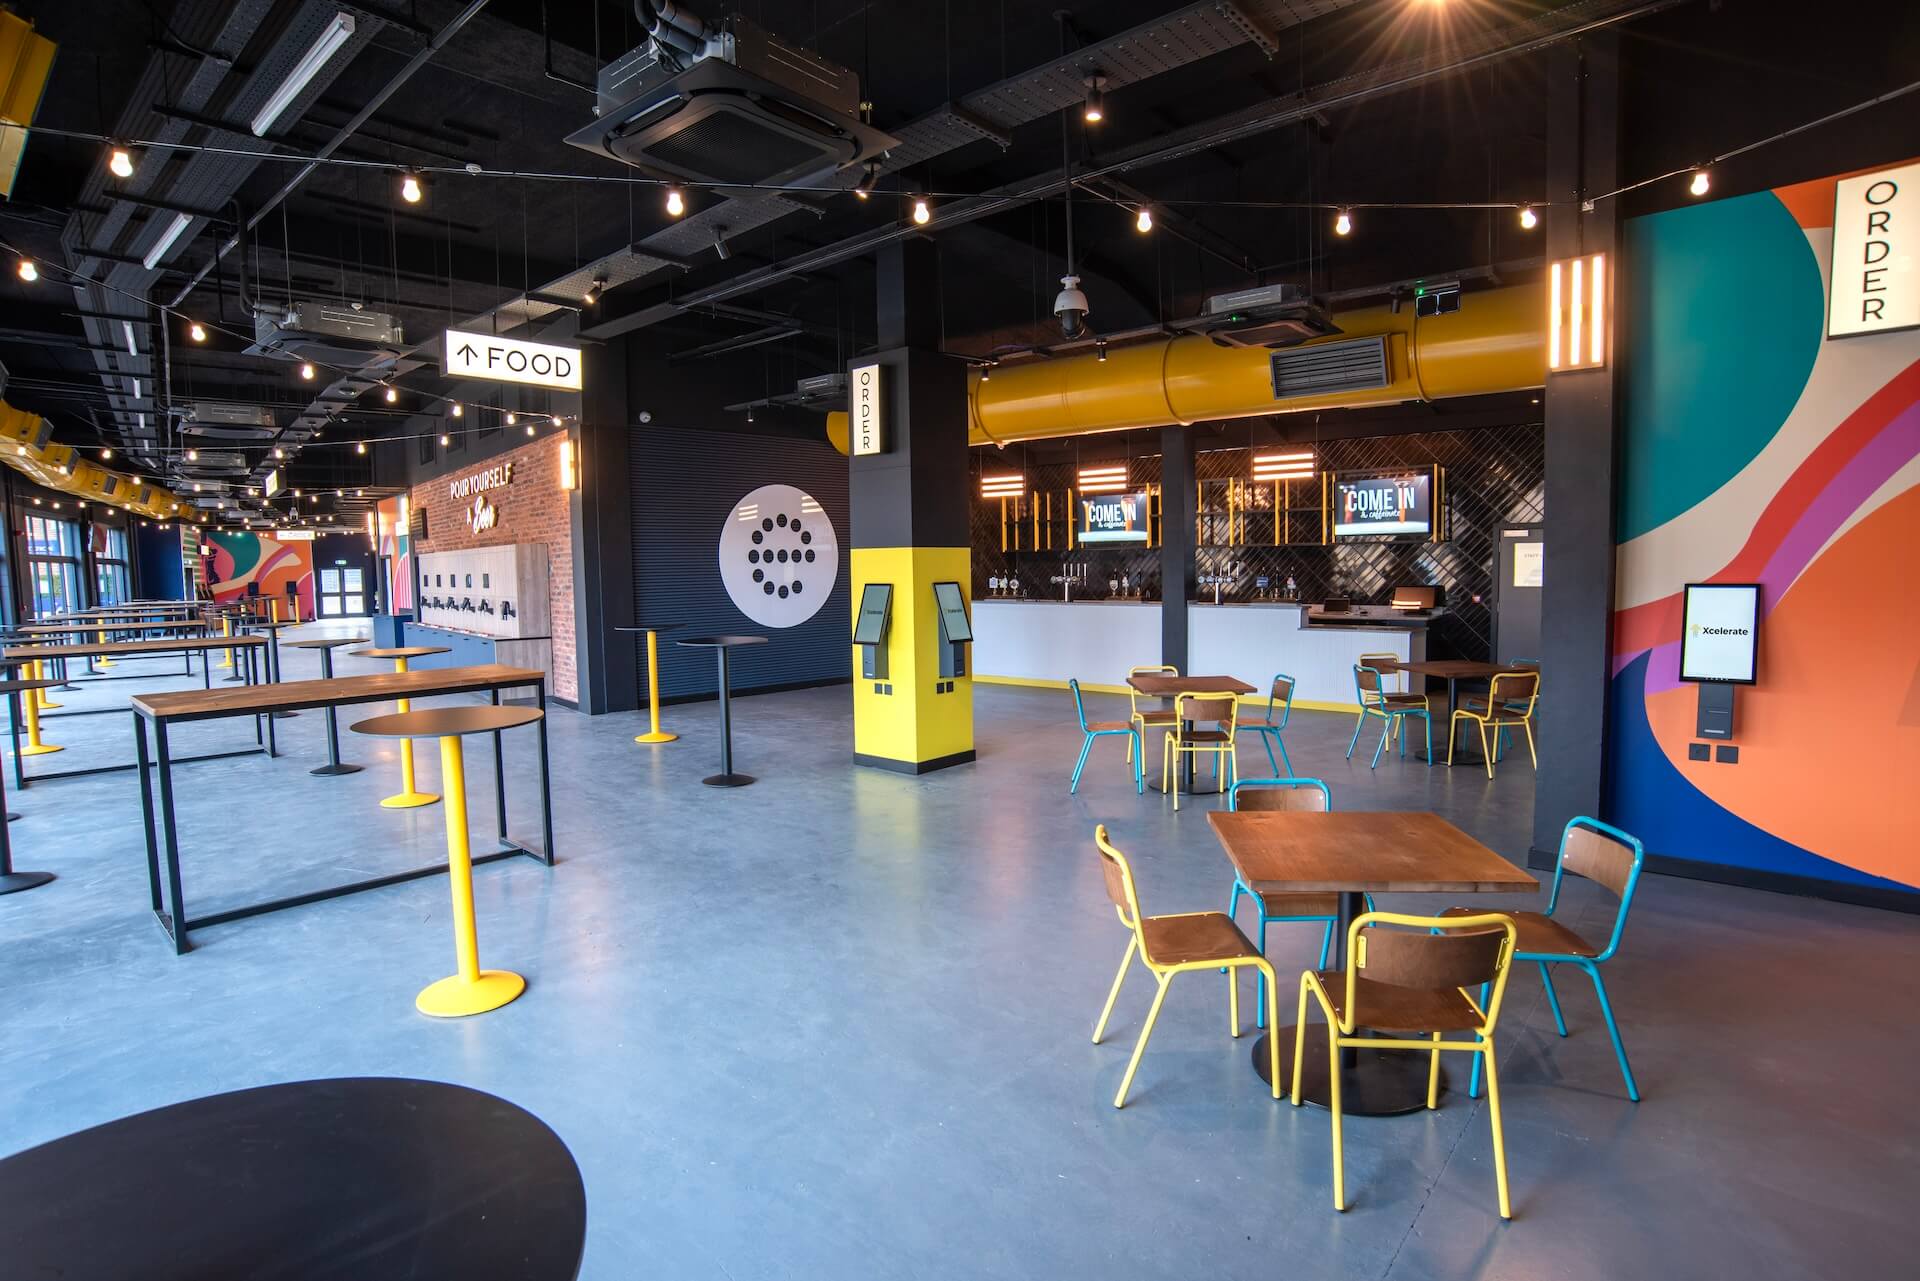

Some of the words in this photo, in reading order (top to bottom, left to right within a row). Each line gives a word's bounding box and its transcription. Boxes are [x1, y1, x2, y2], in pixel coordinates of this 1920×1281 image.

[1861, 180, 1898, 322] ORDER
[488, 346, 571, 377] FOOD
[860, 372, 871, 449] ORDER
[1348, 488, 1394, 512] COME
[1398, 487, 1415, 510] IN
[466, 506, 473, 525] A
[1088, 503, 1121, 523] COME
[1123, 503, 1137, 521] IN
[1702, 626, 1749, 636] Xcelerate
